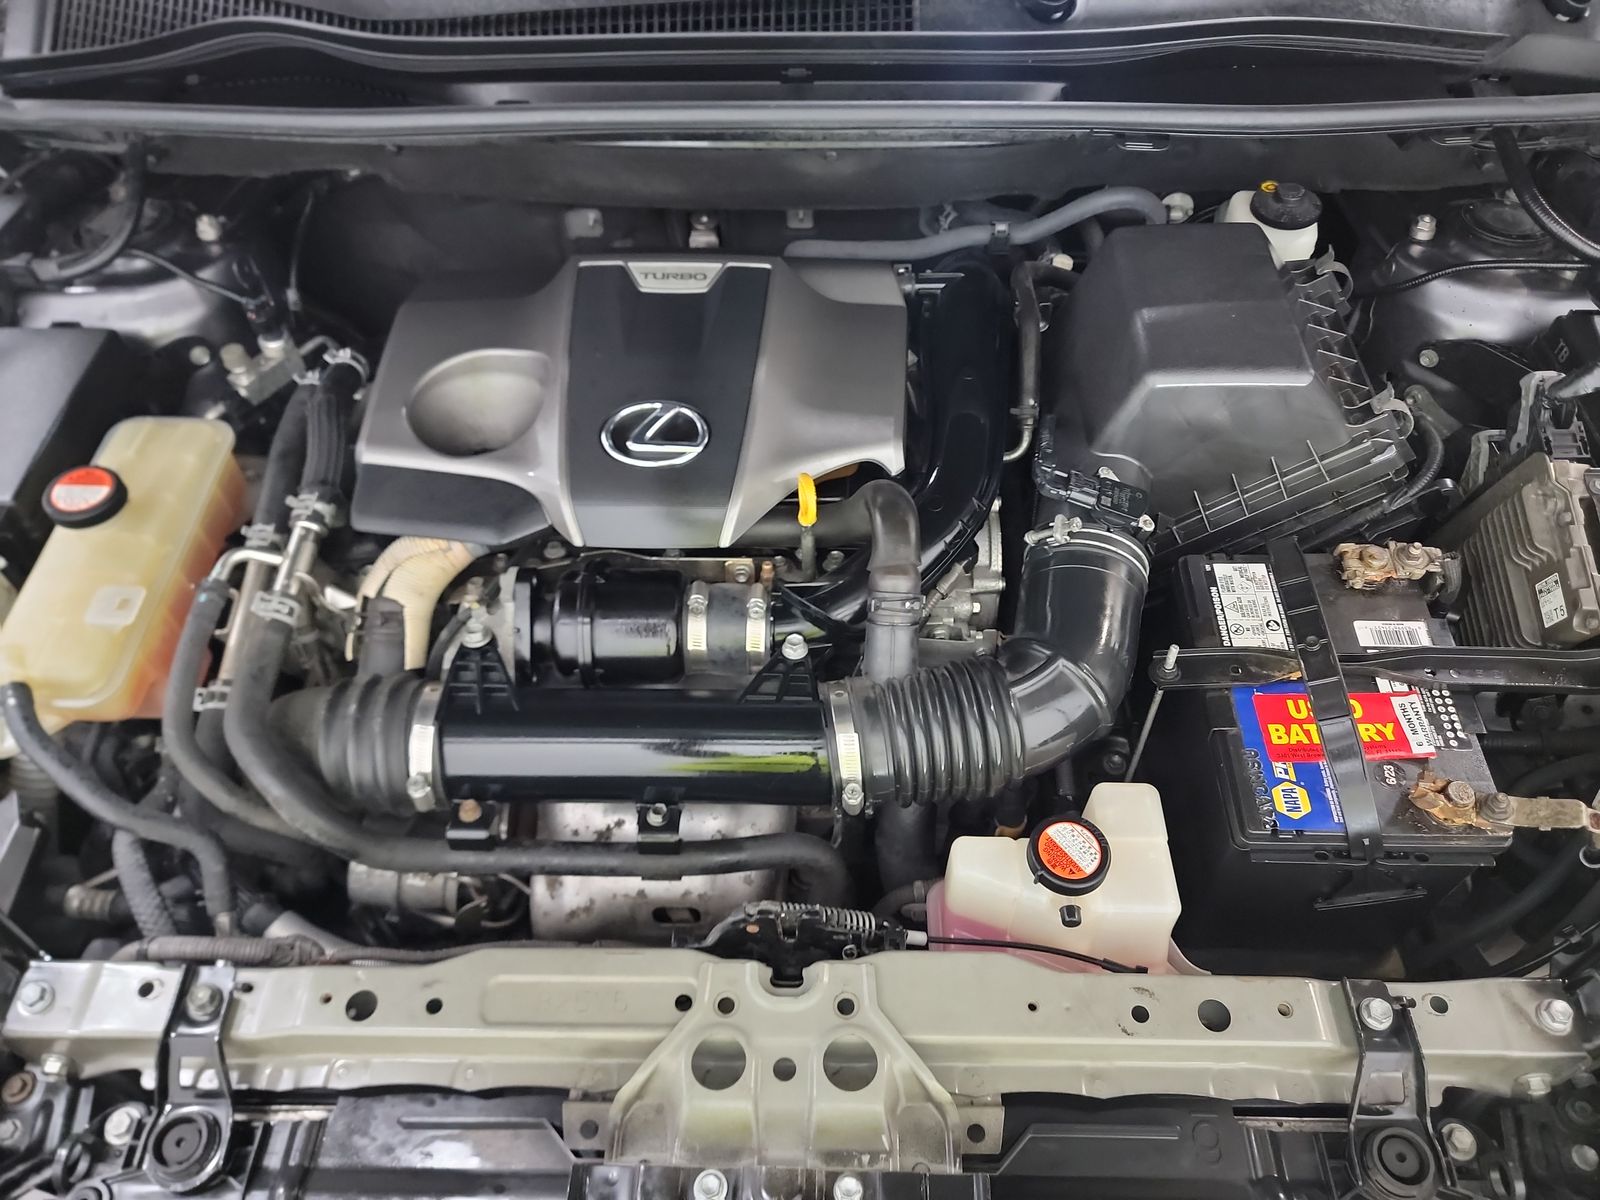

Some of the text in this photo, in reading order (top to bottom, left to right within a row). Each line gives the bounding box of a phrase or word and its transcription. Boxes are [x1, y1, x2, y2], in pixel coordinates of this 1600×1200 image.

[640, 272, 707, 281] TURBO
[1210, 586, 1231, 646] DANGER/POISON
[1399, 703, 1419, 736] MONTHS
[1408, 701, 1434, 747] WARRANTY
[1267, 723, 1395, 745] BATRY
[1383, 765, 1397, 785] 6/23
[1281, 787, 1303, 813] NAPA
